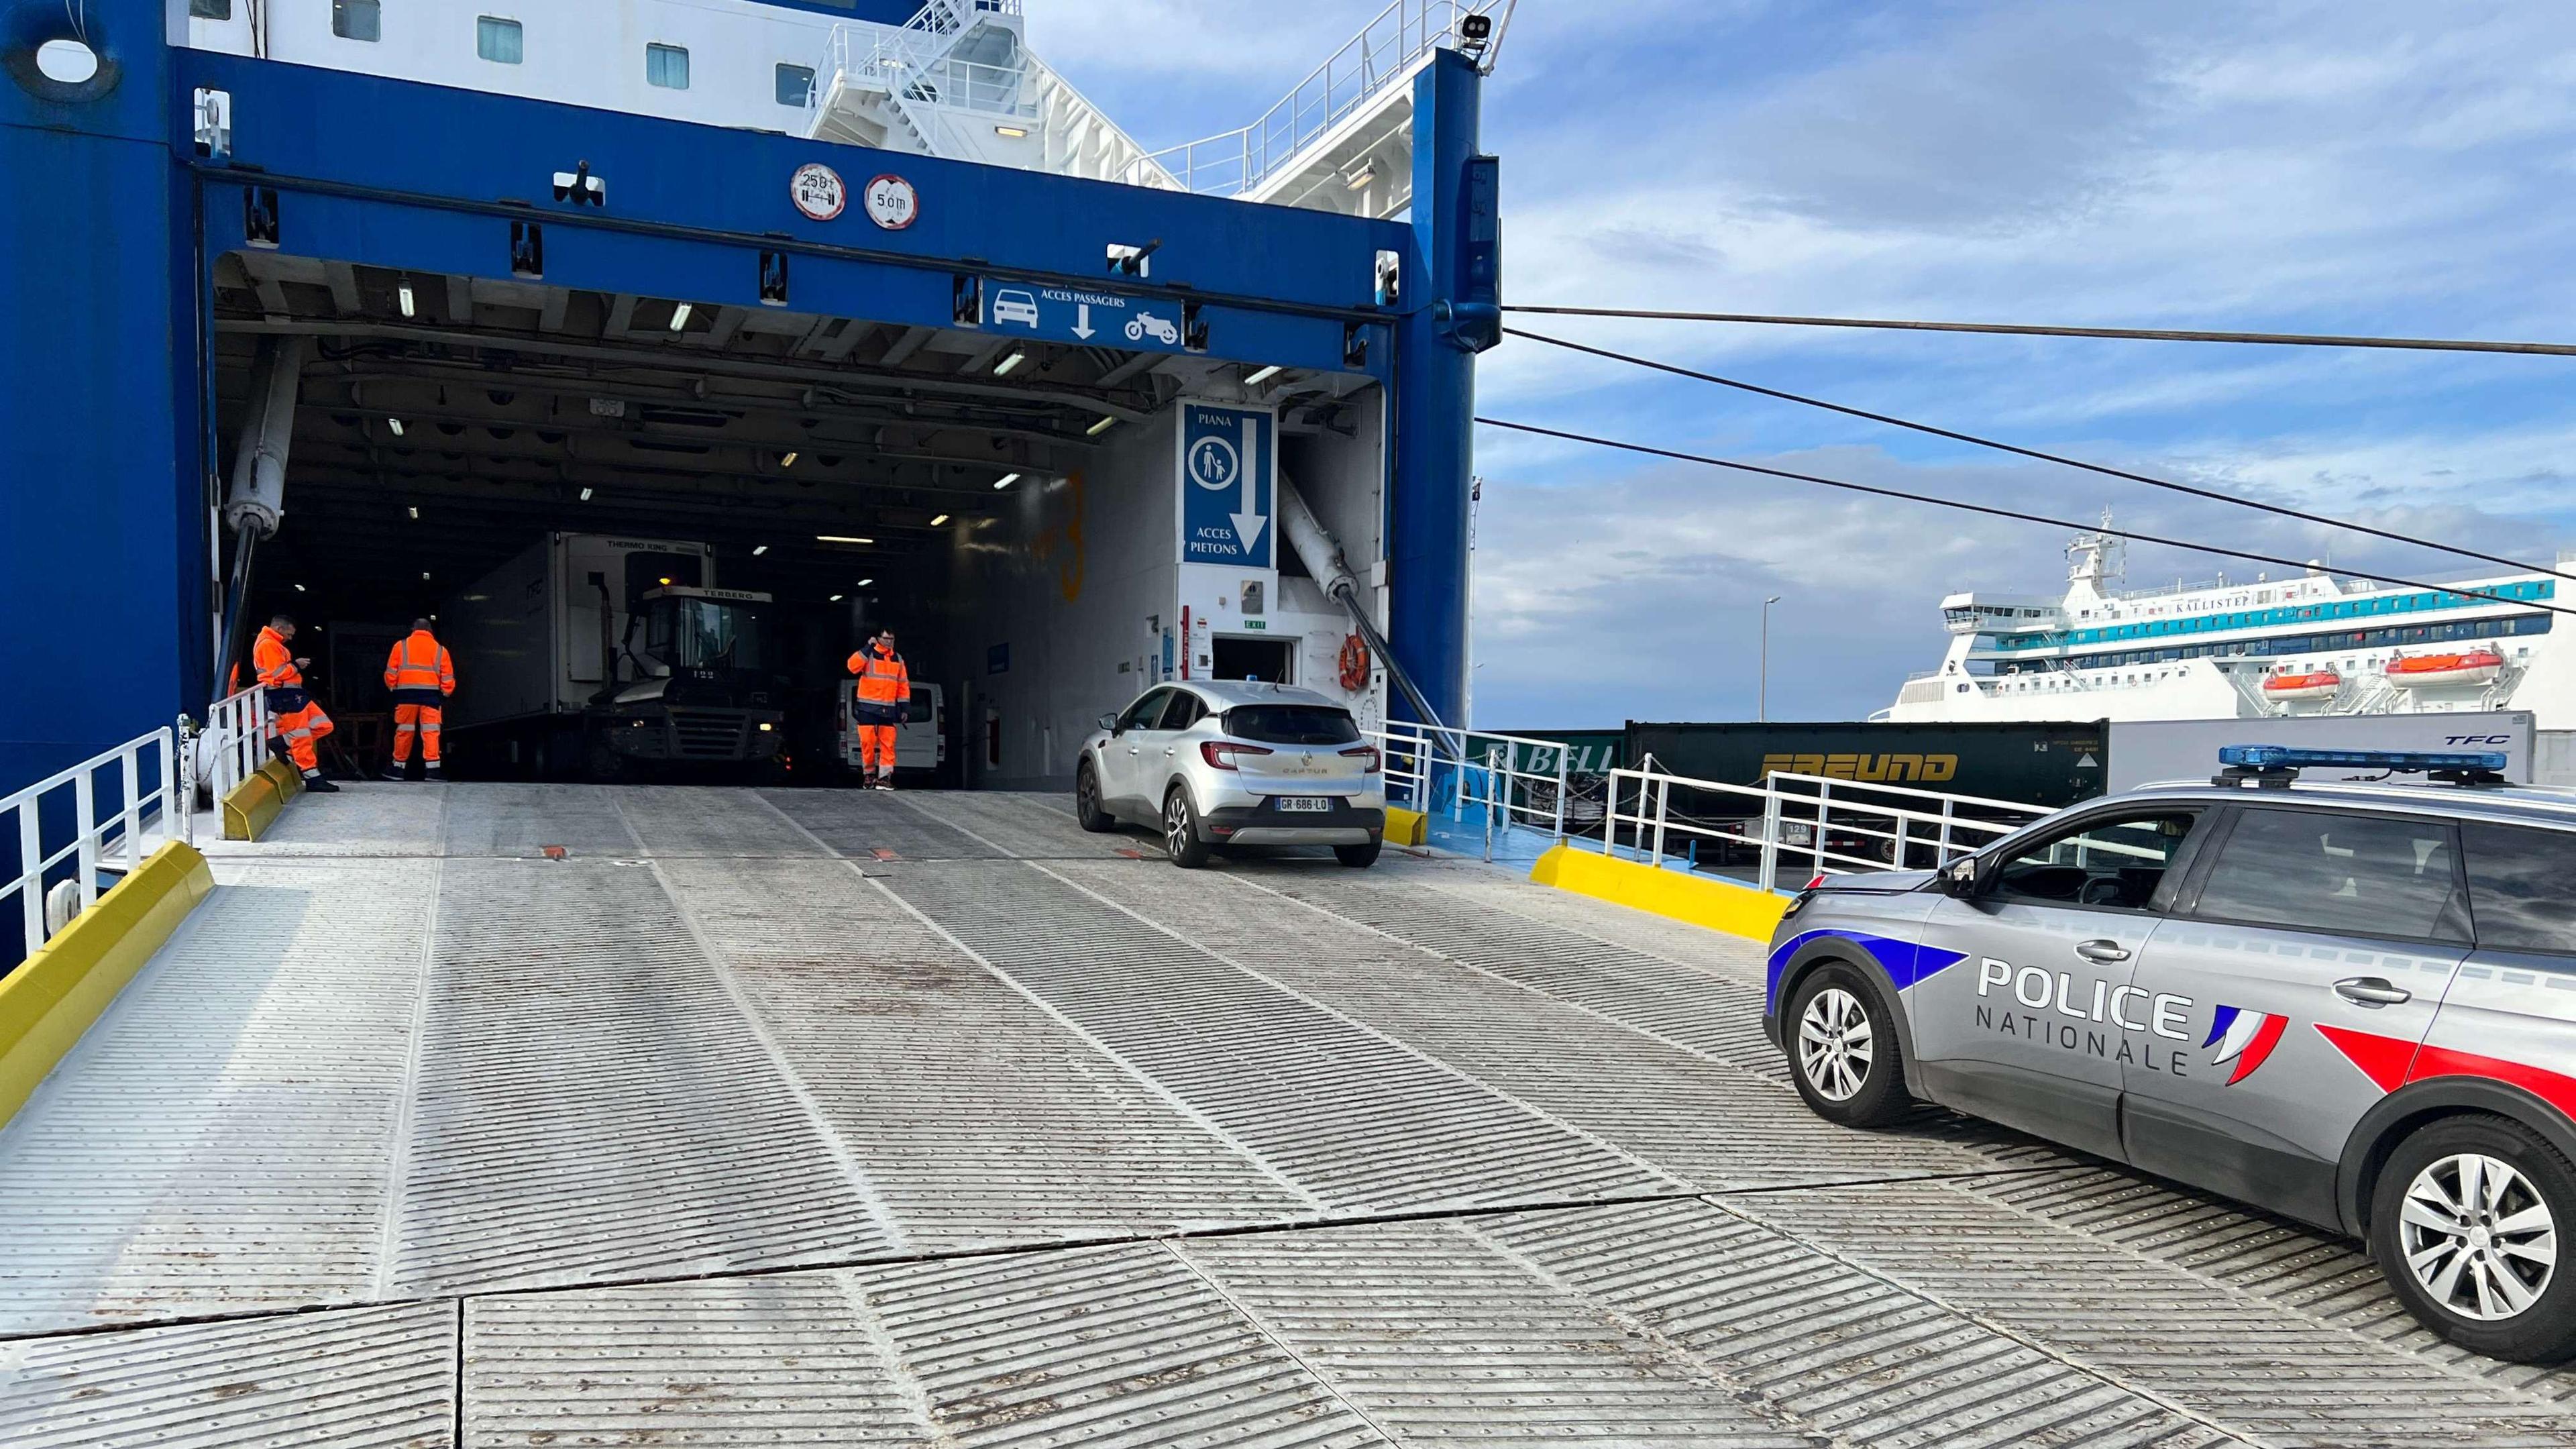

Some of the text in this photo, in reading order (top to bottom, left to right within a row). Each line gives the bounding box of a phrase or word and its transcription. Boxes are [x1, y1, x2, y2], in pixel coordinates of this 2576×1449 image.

[1041, 289, 1125, 307] ACCES PASSAGERS
[1198, 413, 1232, 427] PIANA
[1196, 527, 1231, 539] ACCES
[608, 540, 645, 550] THERMO
[1191, 542, 1237, 555] PIETONS
[704, 590, 753, 600] TERBERG
[2445, 735, 2510, 745] TFC
[1526, 746, 1613, 772] BELL
[1759, 754, 1958, 781] FREUND
[1789, 825, 1807, 833] 129
[1978, 957, 2193, 1041] POLICE
[1976, 1005, 2188, 1077] NATIONALE
